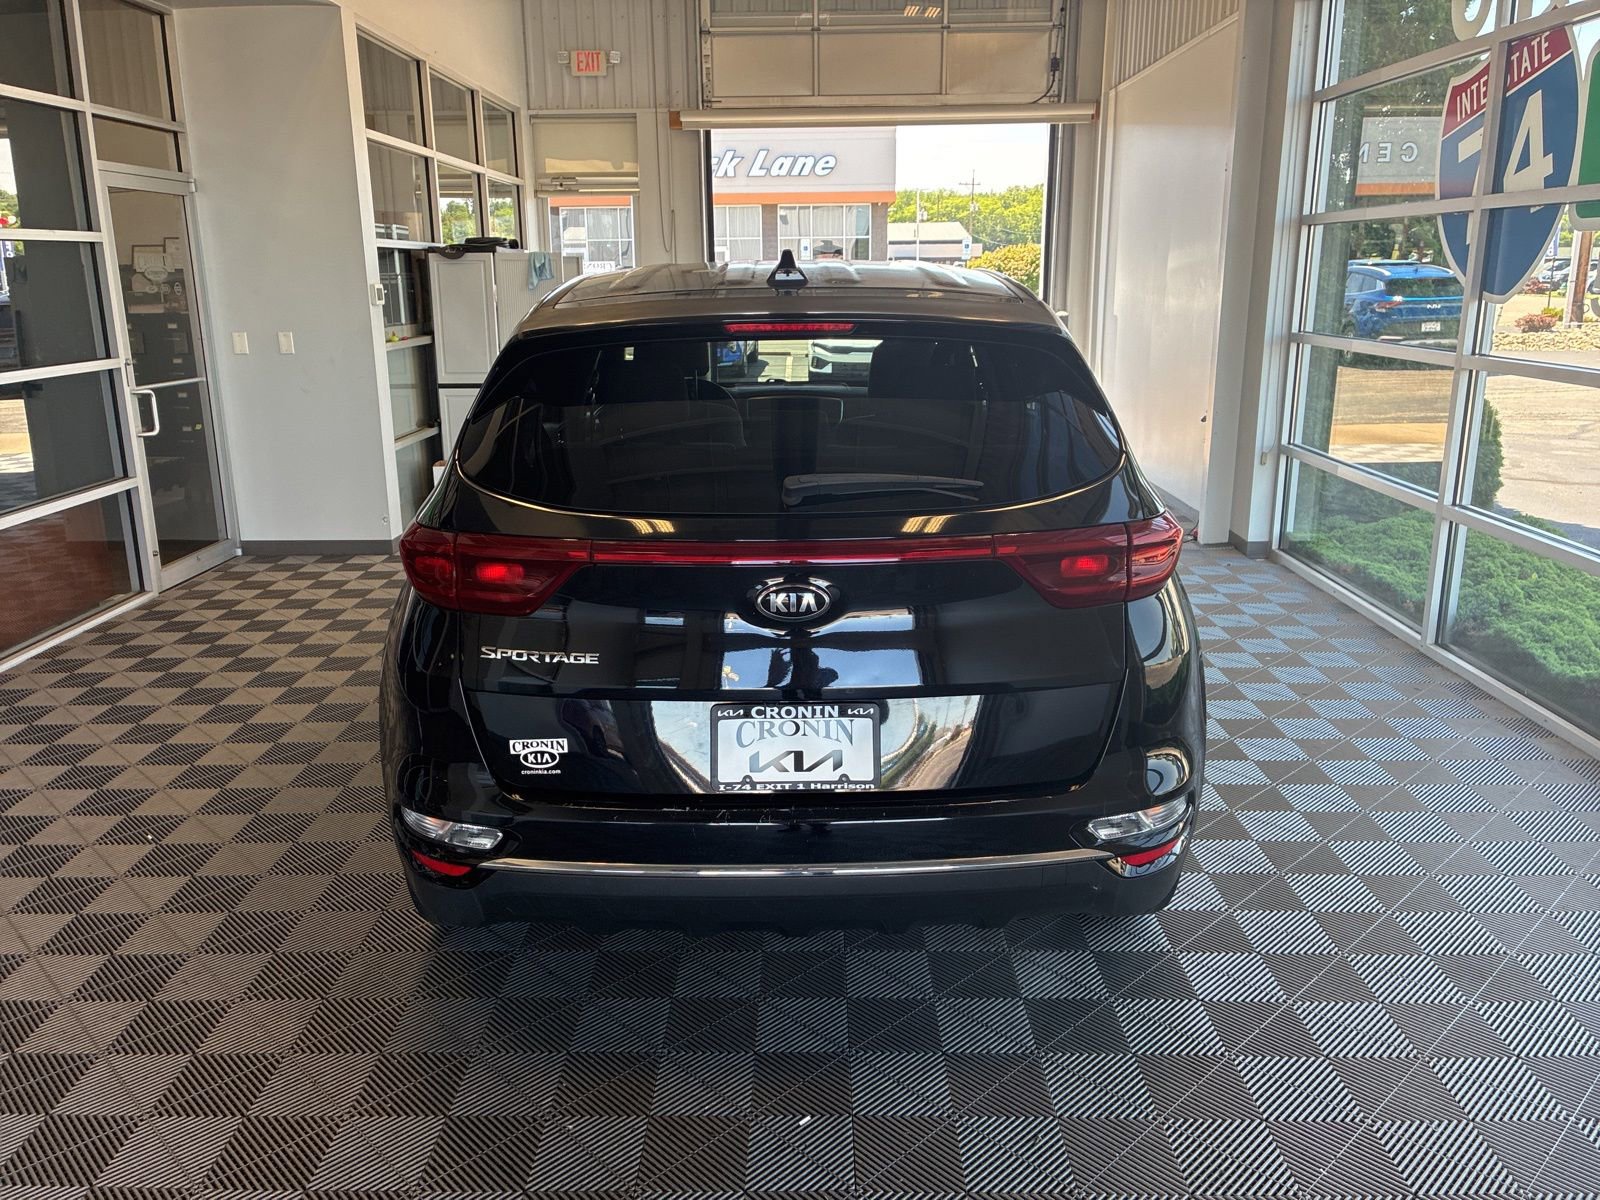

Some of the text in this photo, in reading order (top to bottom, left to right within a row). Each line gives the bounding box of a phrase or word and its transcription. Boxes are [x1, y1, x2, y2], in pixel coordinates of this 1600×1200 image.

[576, 50, 601, 72] EXIT
[747, 149, 837, 177] Lane
[768, 592, 818, 613] KIA
[480, 645, 600, 665] SPORTAGE
[750, 705, 839, 719] CRONIN
[735, 719, 855, 749] CRONIN
[511, 739, 566, 753] CRONIN
[526, 753, 553, 764] KIA
[749, 749, 843, 773] KIA
[810, 782, 875, 790] Harrison
